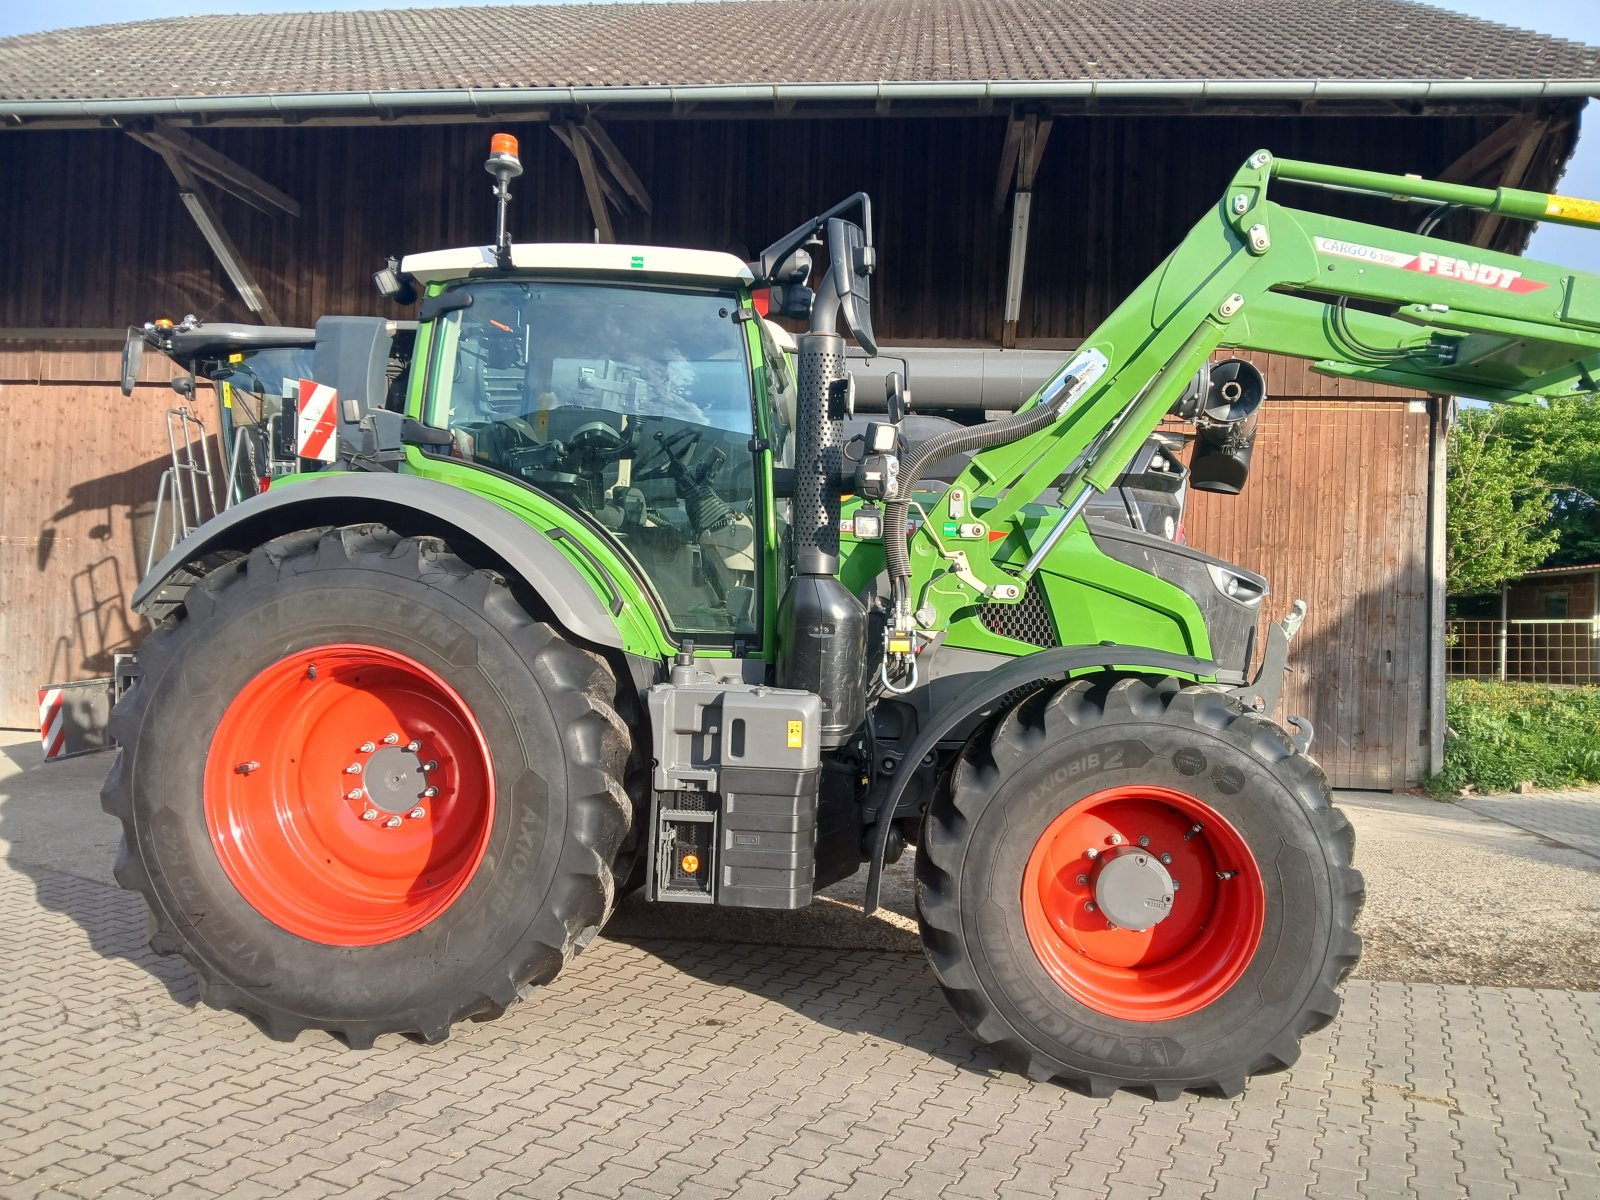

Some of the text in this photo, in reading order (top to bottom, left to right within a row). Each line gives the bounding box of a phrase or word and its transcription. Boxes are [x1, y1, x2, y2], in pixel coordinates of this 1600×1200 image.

[1322, 240, 1367, 257] CARGO
[1418, 251, 1522, 288] FENDT
[1027, 745, 1125, 805] AXIOBIB 2
[982, 916, 1117, 1058] MICHELIN
